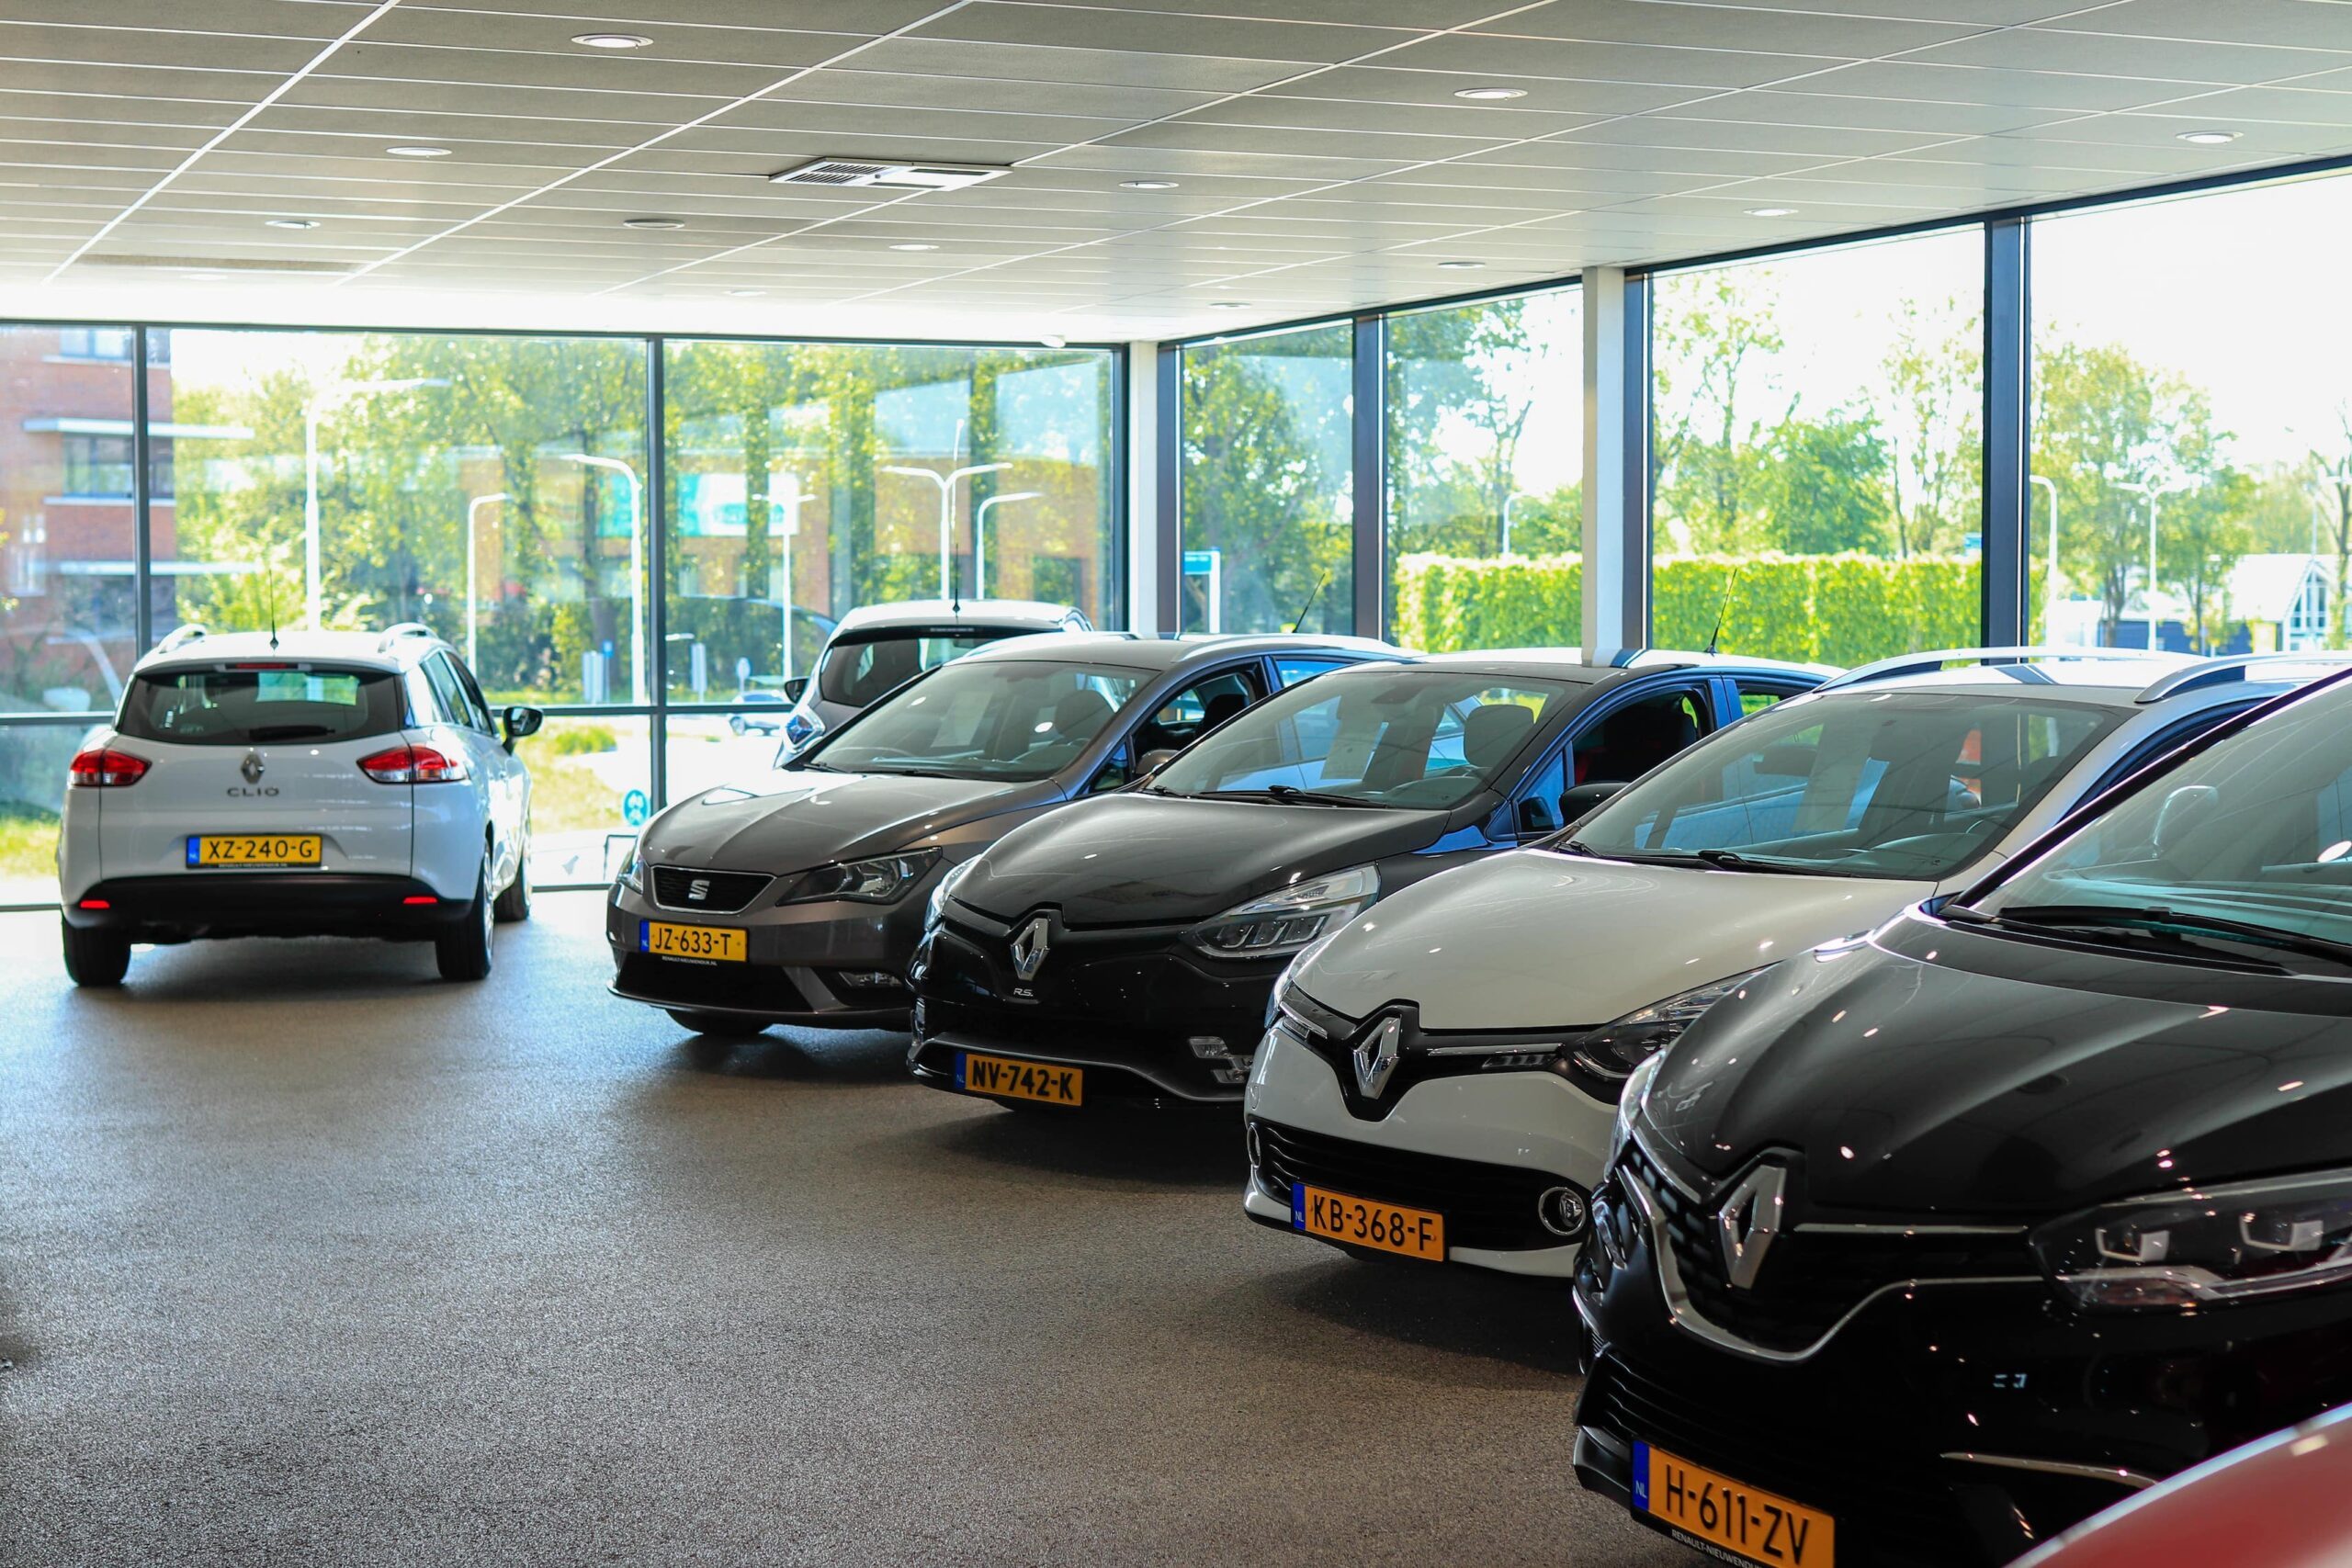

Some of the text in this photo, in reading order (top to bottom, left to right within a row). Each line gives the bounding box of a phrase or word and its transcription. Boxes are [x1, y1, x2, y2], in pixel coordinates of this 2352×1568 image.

[227, 787, 279, 796] CLIO
[209, 840, 312, 859] XZ-240-G
[655, 928, 731, 955] JZ-633-T
[956, 1059, 1074, 1100] NL NV-742-K
[1295, 1194, 1433, 1251] NL KB-368-F
[1635, 1464, 1810, 1565] NL H-611-ZV
